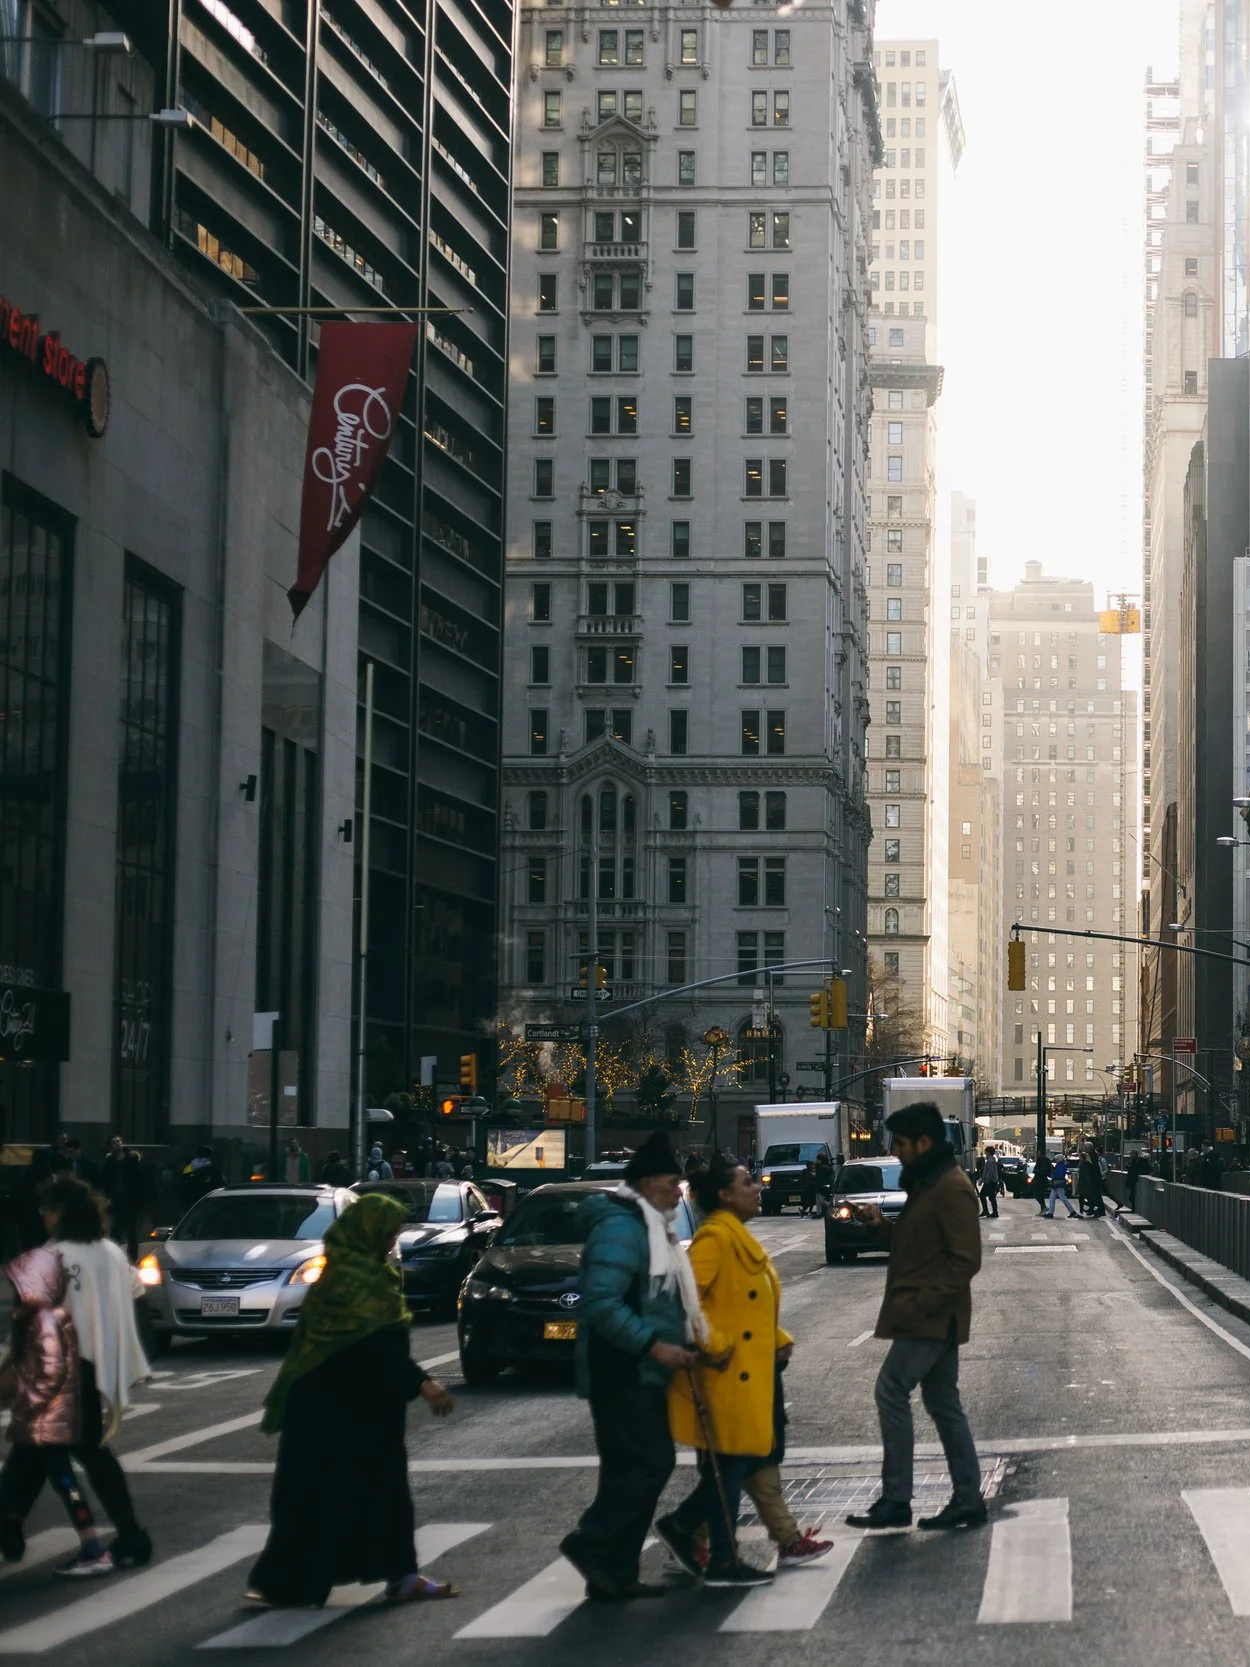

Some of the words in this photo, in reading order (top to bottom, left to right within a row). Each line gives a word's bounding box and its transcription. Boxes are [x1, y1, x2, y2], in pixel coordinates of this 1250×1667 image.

[42, 333, 88, 401] store
[311, 383, 391, 533] Century
[120, 1017, 152, 1066] 24/7
[527, 1028, 560, 1039] Cortlandt
